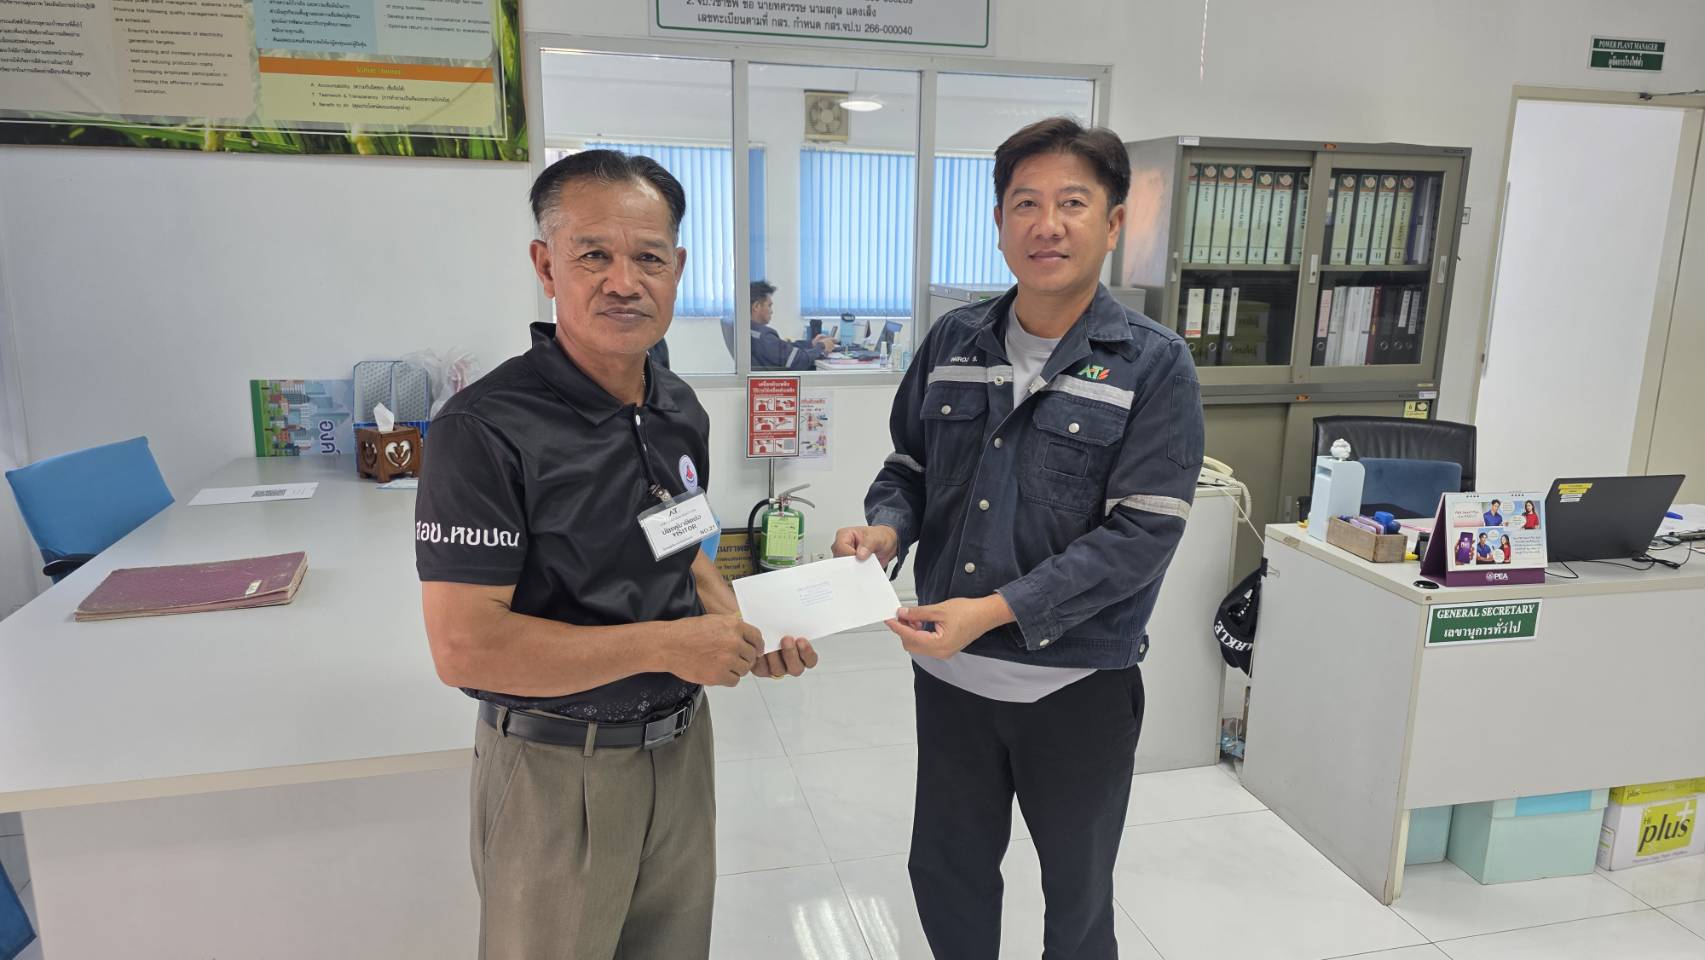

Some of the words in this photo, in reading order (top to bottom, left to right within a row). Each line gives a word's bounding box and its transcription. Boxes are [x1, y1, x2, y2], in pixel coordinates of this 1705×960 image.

[809, 4, 843, 18] นามสกุล
[698, 11, 768, 26] เลขทะเบียนตามที่
[771, 17, 790, 27] กสร.
[793, 16, 822, 31] กำหนด
[864, 24, 913, 36] 266-000040
[1598, 40, 1617, 49] POWER
[1617, 41, 1634, 49] PLANT
[1634, 42, 1659, 51] MANAGER
[672, 524, 698, 538] VISITOR
[1493, 572, 1509, 581] PEA
[1436, 607, 1481, 619] GENERAL
[1481, 604, 1535, 616] SECRETARY
[1444, 618, 1522, 639] เลขานุการทั่วไป
[1637, 813, 1691, 853] plus
